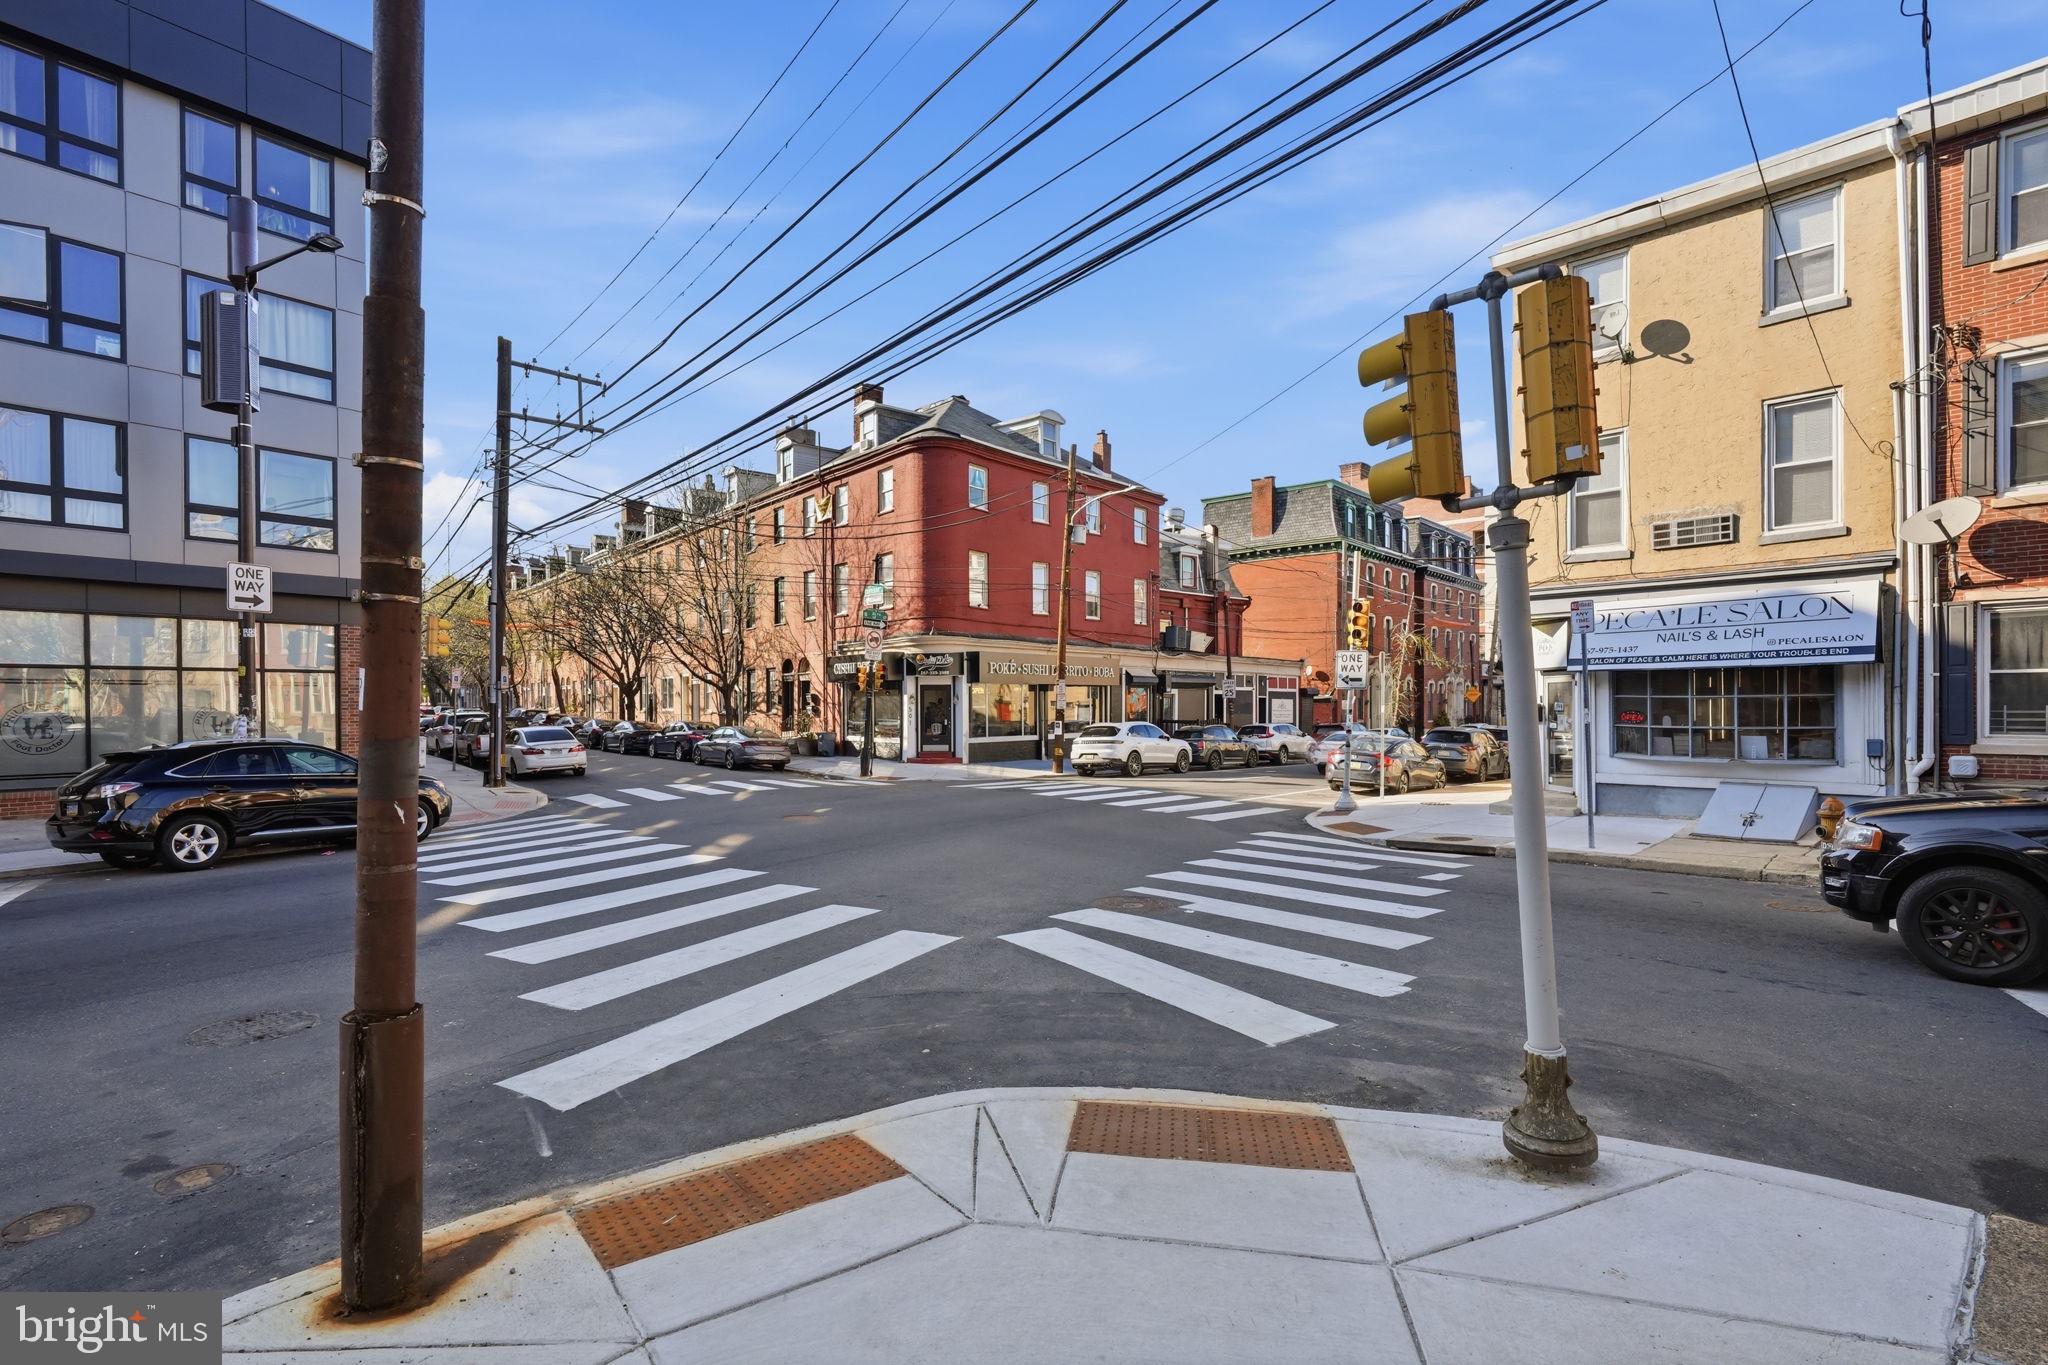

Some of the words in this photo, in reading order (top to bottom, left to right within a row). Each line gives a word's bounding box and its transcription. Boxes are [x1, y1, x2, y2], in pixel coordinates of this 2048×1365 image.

[235, 567, 264, 580] ONE
[235, 580, 264, 593] WAY
[1727, 594, 1854, 622] SALON
[1656, 631, 1701, 643] NAIL'S
[1707, 630, 1718, 641] &
[1724, 627, 1765, 640] LASH
[1341, 654, 1363, 663] ONE
[1719, 652, 1750, 660] WHERE
[1752, 650, 1777, 658] YOUR
[1780, 648, 1828, 657] TROUBLES
[1829, 647, 1850, 655] END
[990, 659, 1017, 675] POKÉ
[1022, 664, 1049, 676] SUSHI
[1052, 664, 1089, 677] BRRITO
[1093, 667, 1115, 678] BOBA
[1341, 664, 1363, 672] WAY
[35, 738, 65, 753] Doctor
